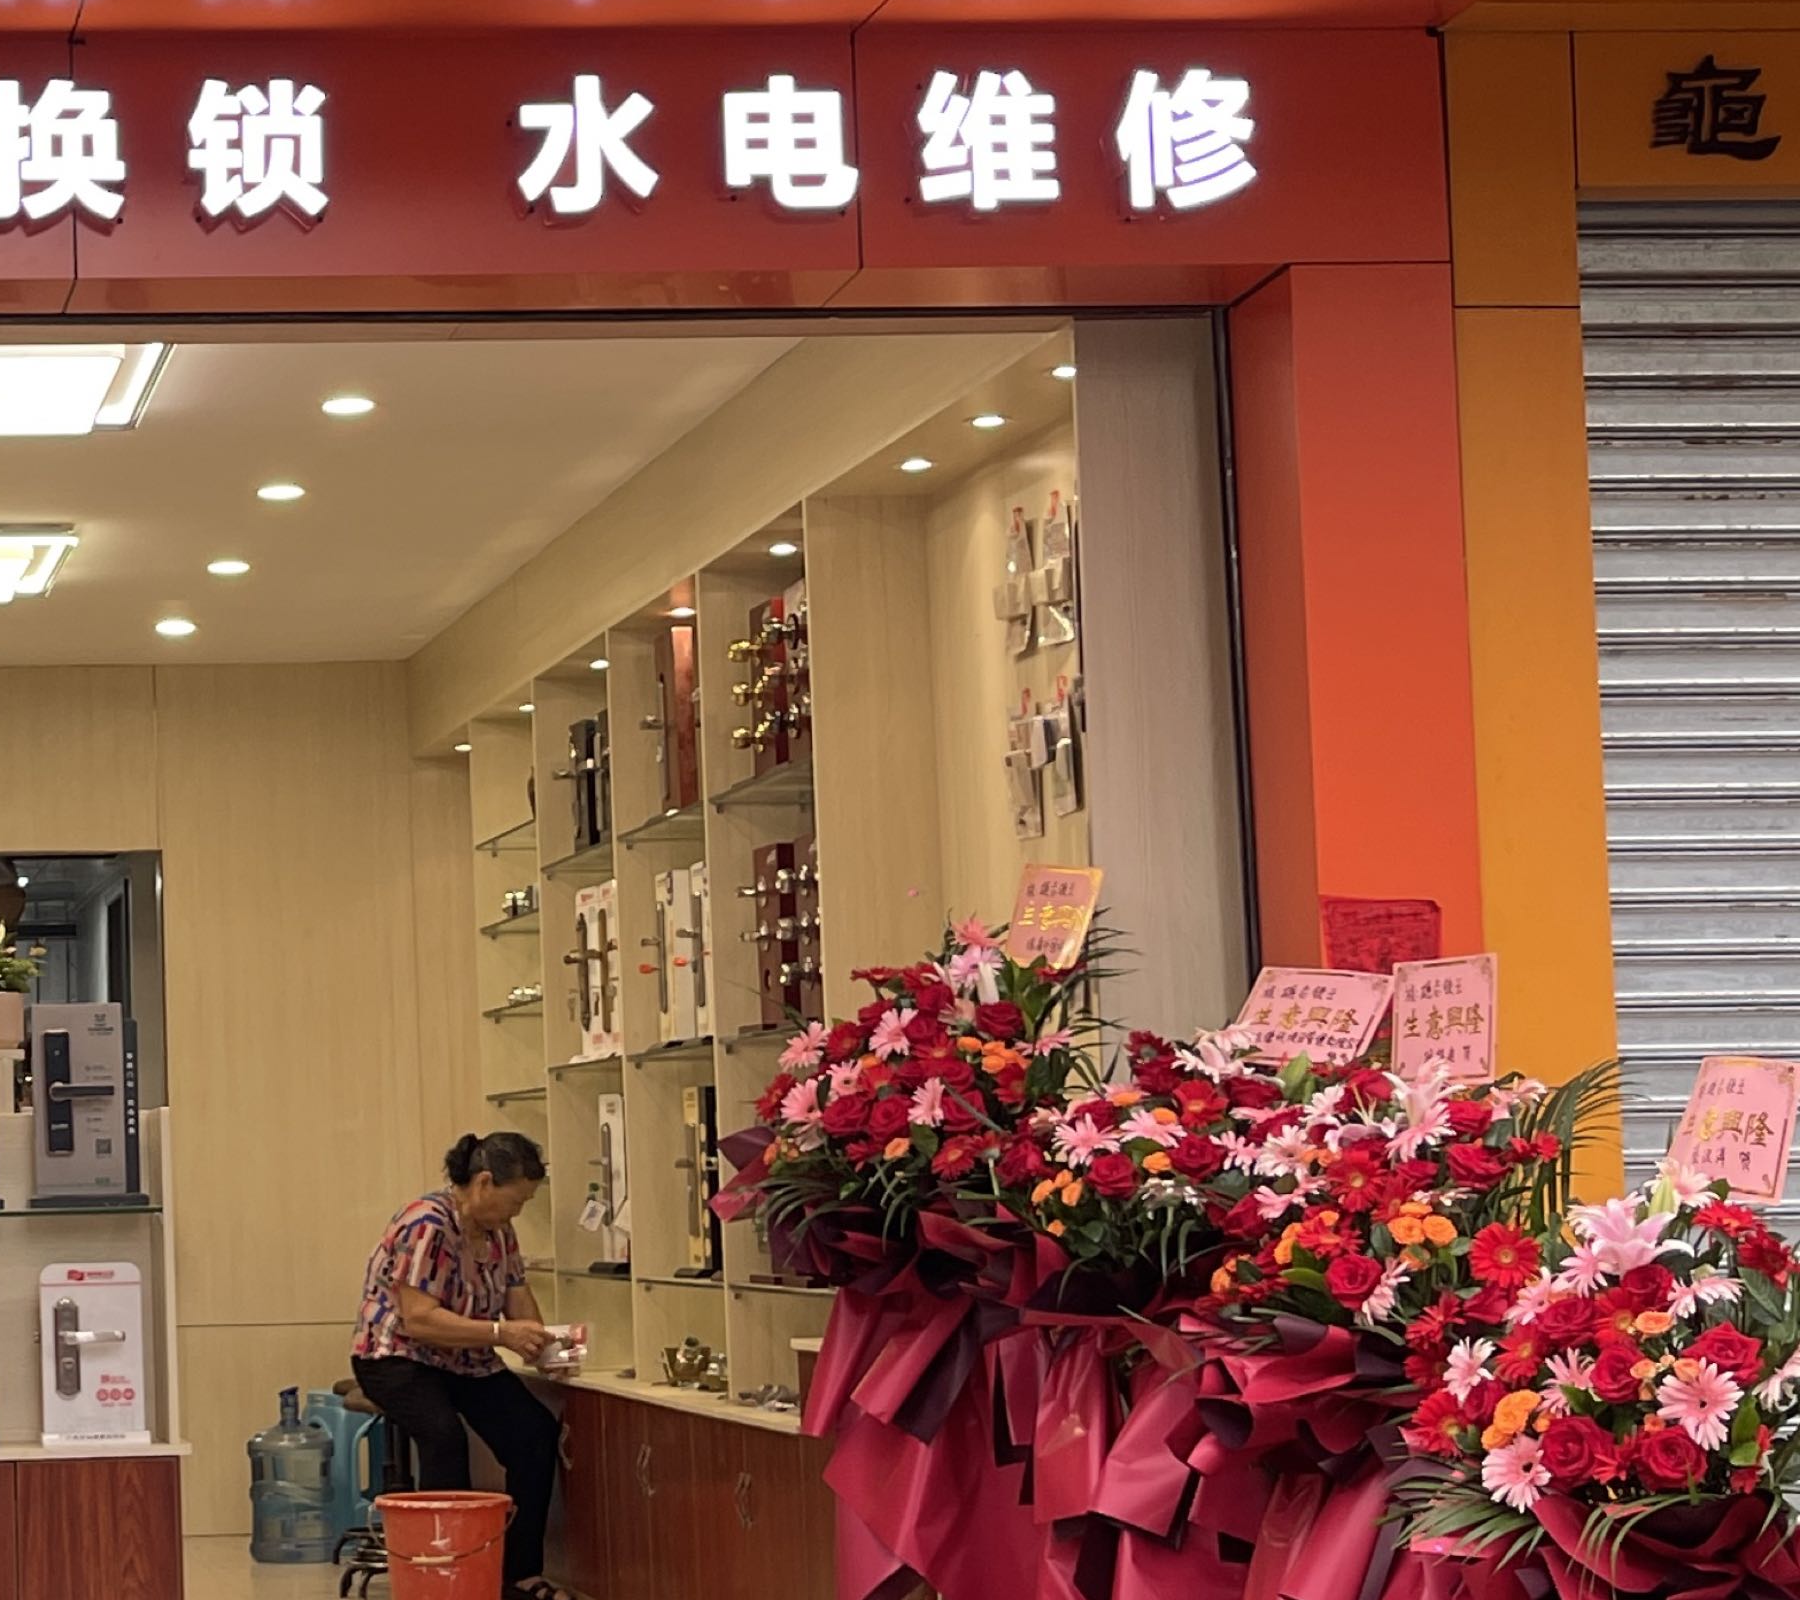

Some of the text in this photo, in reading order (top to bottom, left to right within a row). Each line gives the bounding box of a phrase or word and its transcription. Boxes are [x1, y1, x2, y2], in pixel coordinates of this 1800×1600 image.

[516, 68, 1258, 218] 水电维修
[1403, 1003, 1485, 1040] 生意興隆
